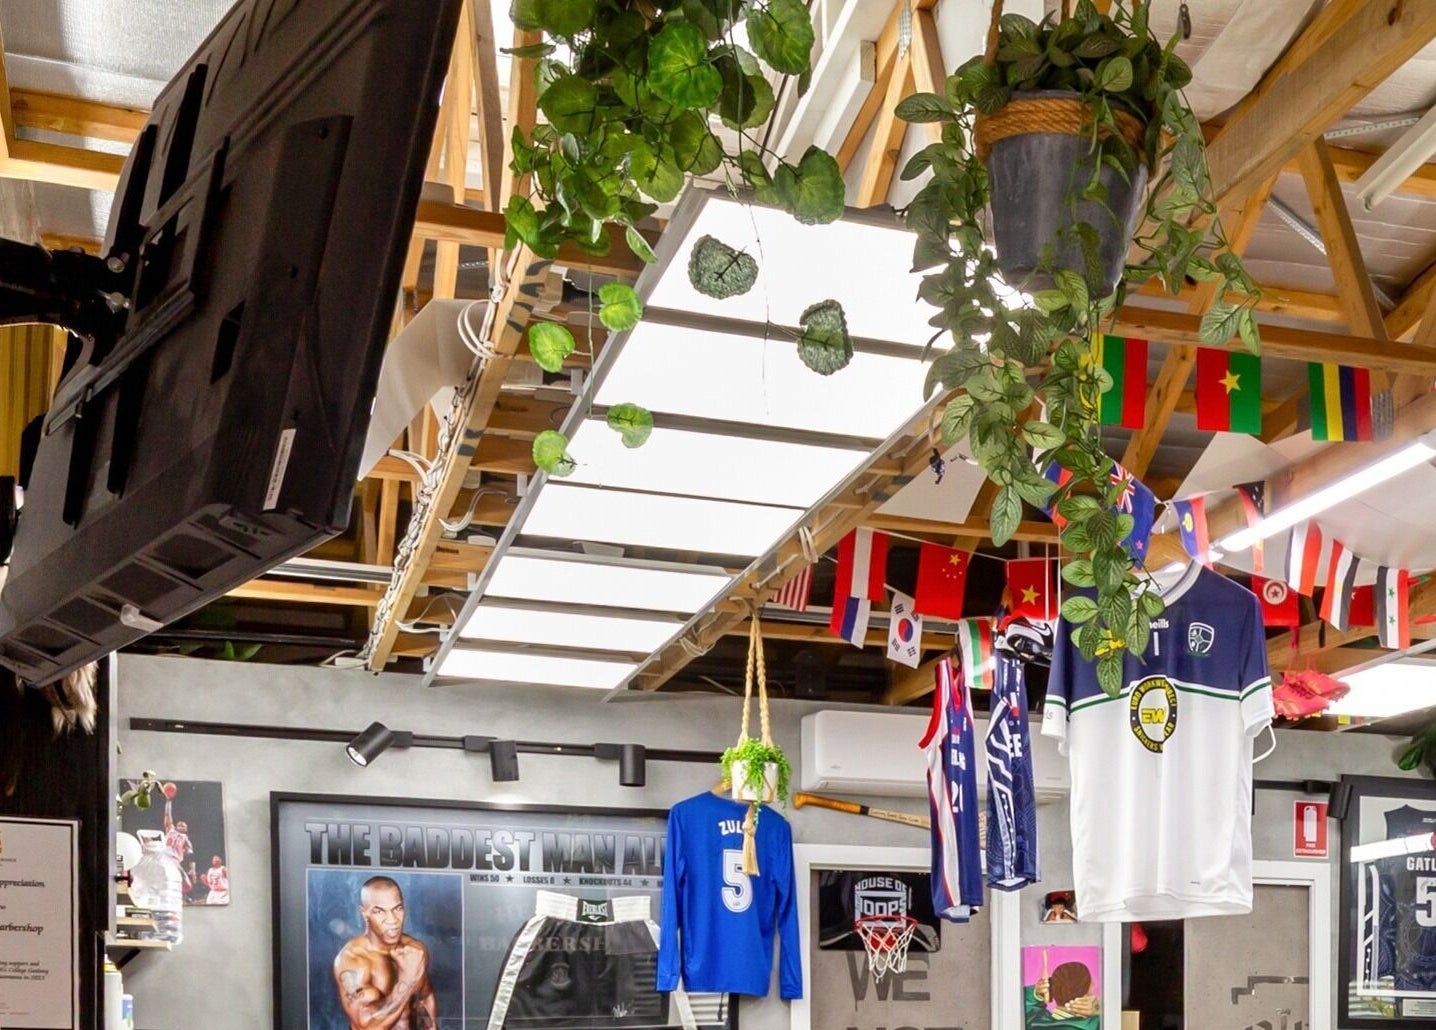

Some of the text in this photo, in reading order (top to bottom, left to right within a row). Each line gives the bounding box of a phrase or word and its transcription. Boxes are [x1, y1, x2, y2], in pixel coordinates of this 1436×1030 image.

[305, 822, 371, 866] THE
[379, 825, 536, 872] BADDEST
[541, 832, 616, 875] MAN
[0, 878, 46, 889] ppreciation
[470, 874, 489, 883] WINS
[523, 876, 548, 884] LOSSES
[579, 877, 621, 886] KNOCKOUTS
[721, 849, 754, 913] 5
[854, 875, 892, 892] HOUSE
[0, 923, 45, 935] arbershop
[846, 951, 931, 1001] WE
